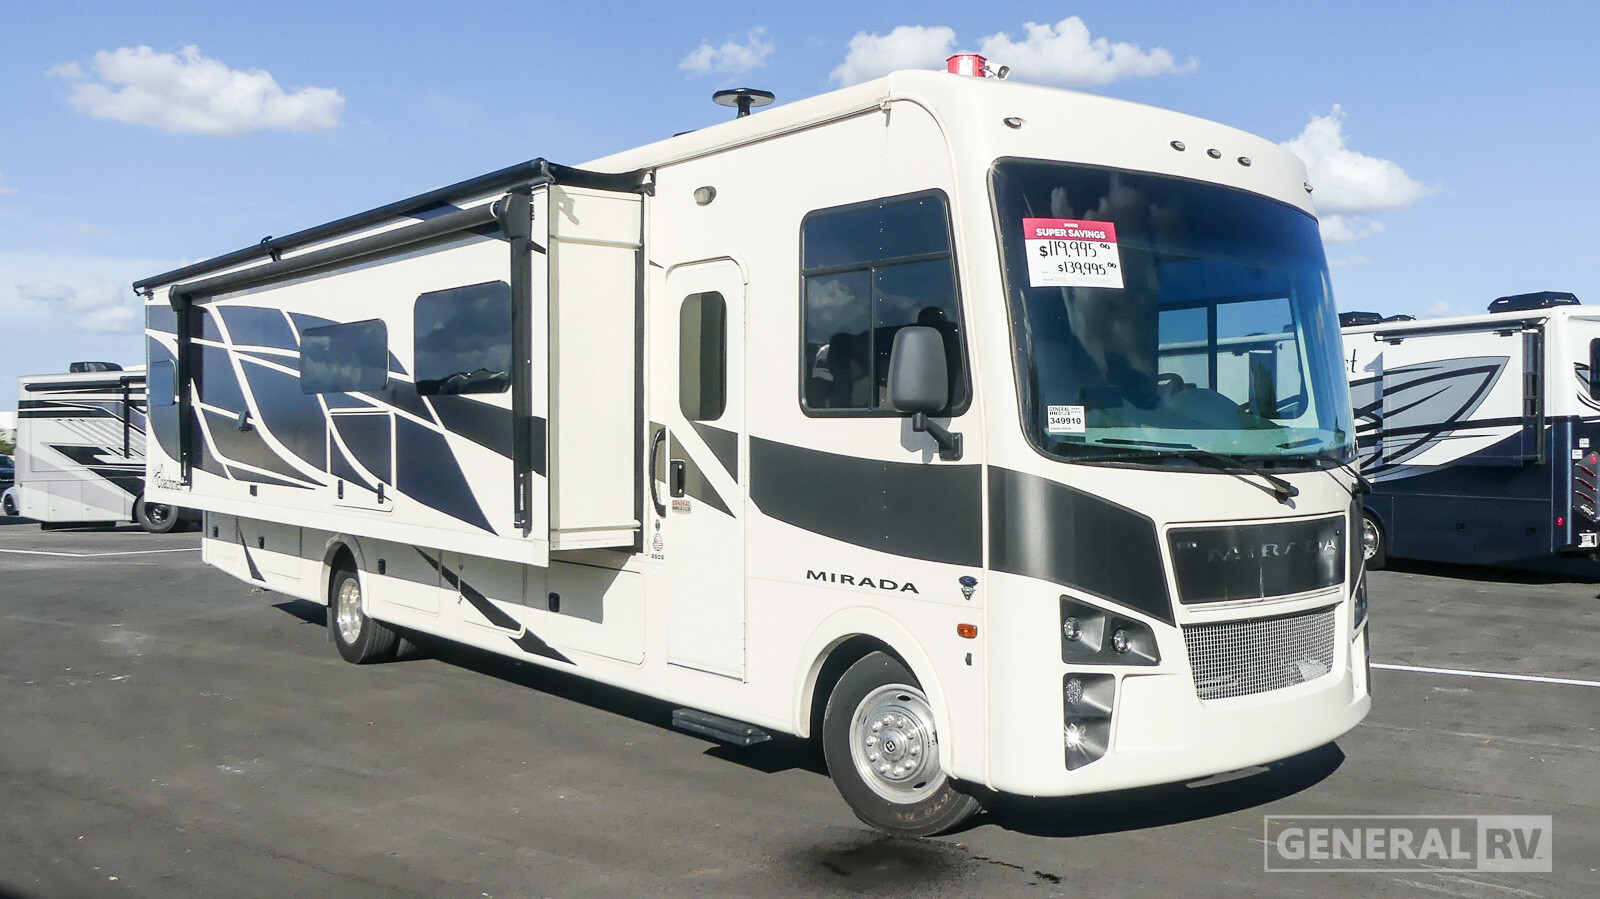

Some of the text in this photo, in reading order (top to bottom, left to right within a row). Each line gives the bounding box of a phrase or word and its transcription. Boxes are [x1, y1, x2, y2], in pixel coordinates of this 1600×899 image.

[1036, 228, 1106, 239] SUPER SAVINGS
[1050, 417, 1081, 425] 349910
[806, 569, 920, 594] MIRADA
